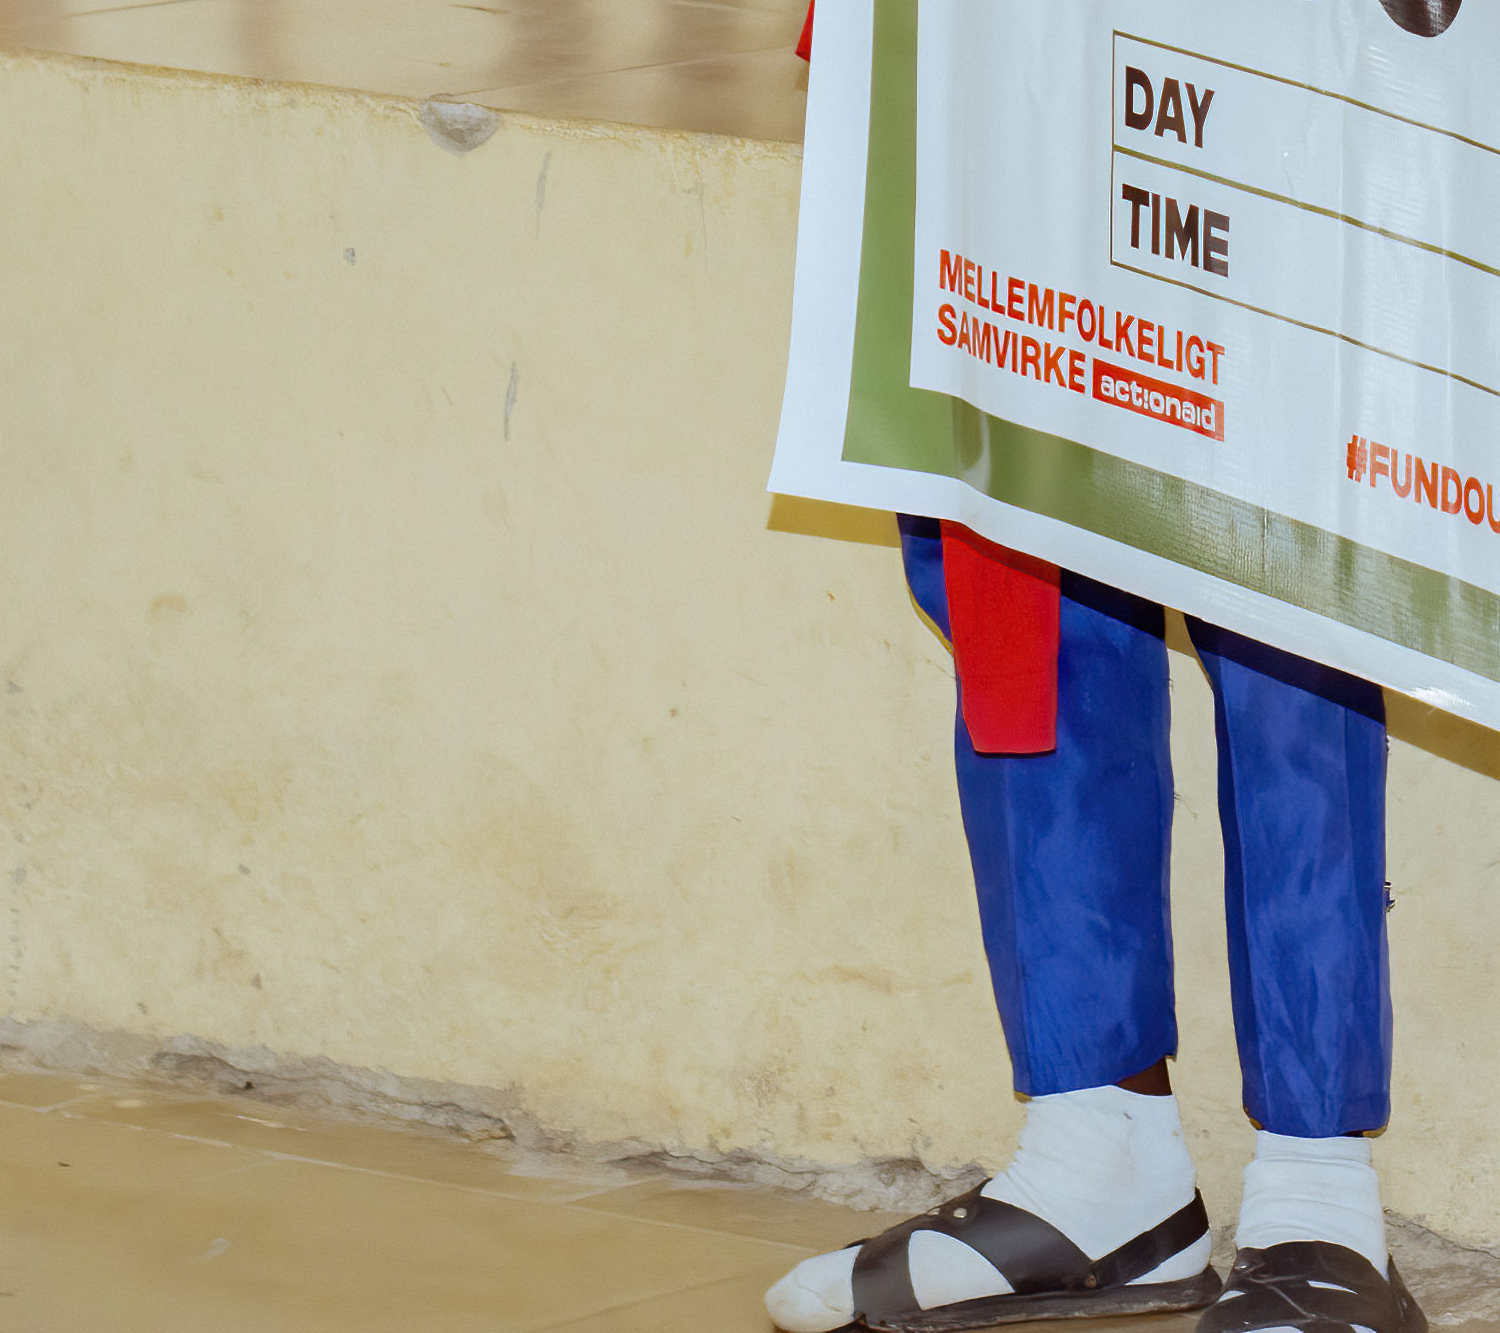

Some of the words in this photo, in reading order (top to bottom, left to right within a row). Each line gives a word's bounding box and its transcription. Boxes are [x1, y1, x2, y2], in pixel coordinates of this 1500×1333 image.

[1124, 65, 1216, 149] DAY
[1121, 183, 1230, 278] TIME
[937, 303, 1086, 394] SAMVIRKE
[939, 249, 1225, 385] MELLEMFOLKELIGT
